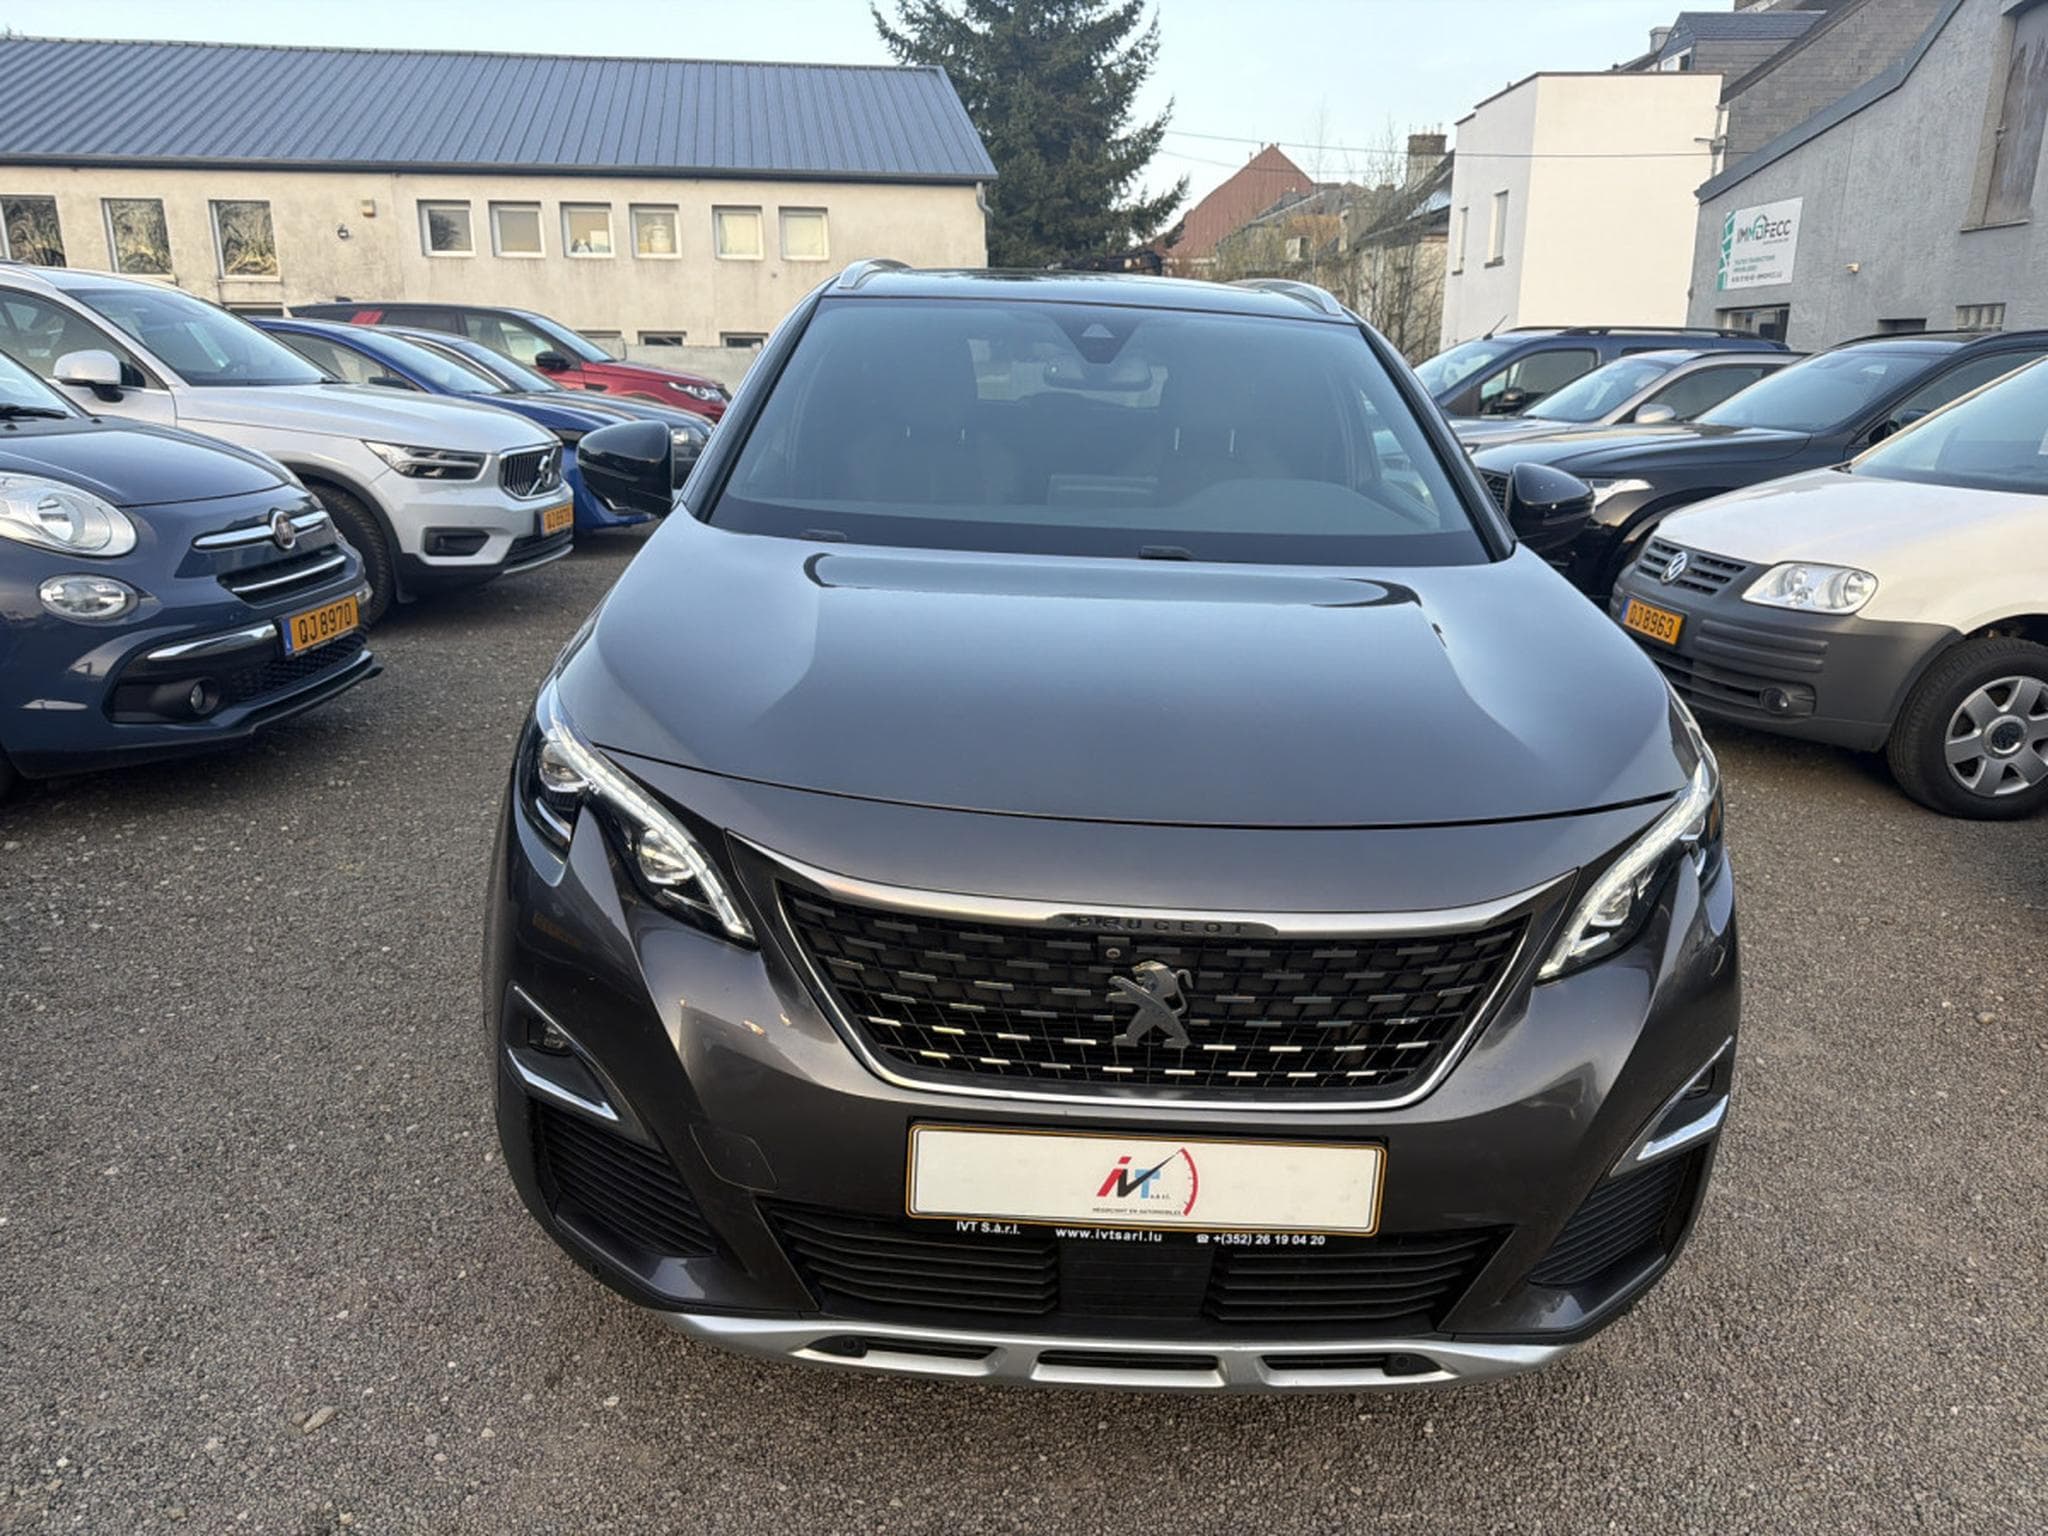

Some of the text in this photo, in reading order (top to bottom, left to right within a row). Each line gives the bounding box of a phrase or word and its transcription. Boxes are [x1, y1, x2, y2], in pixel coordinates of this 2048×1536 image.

[956, 1221, 977, 1232] IVT
[1055, 1228, 1163, 1242] www.ivtsarl.lu
[1213, 1233, 1326, 1246] +(352) 26 19 04 20
